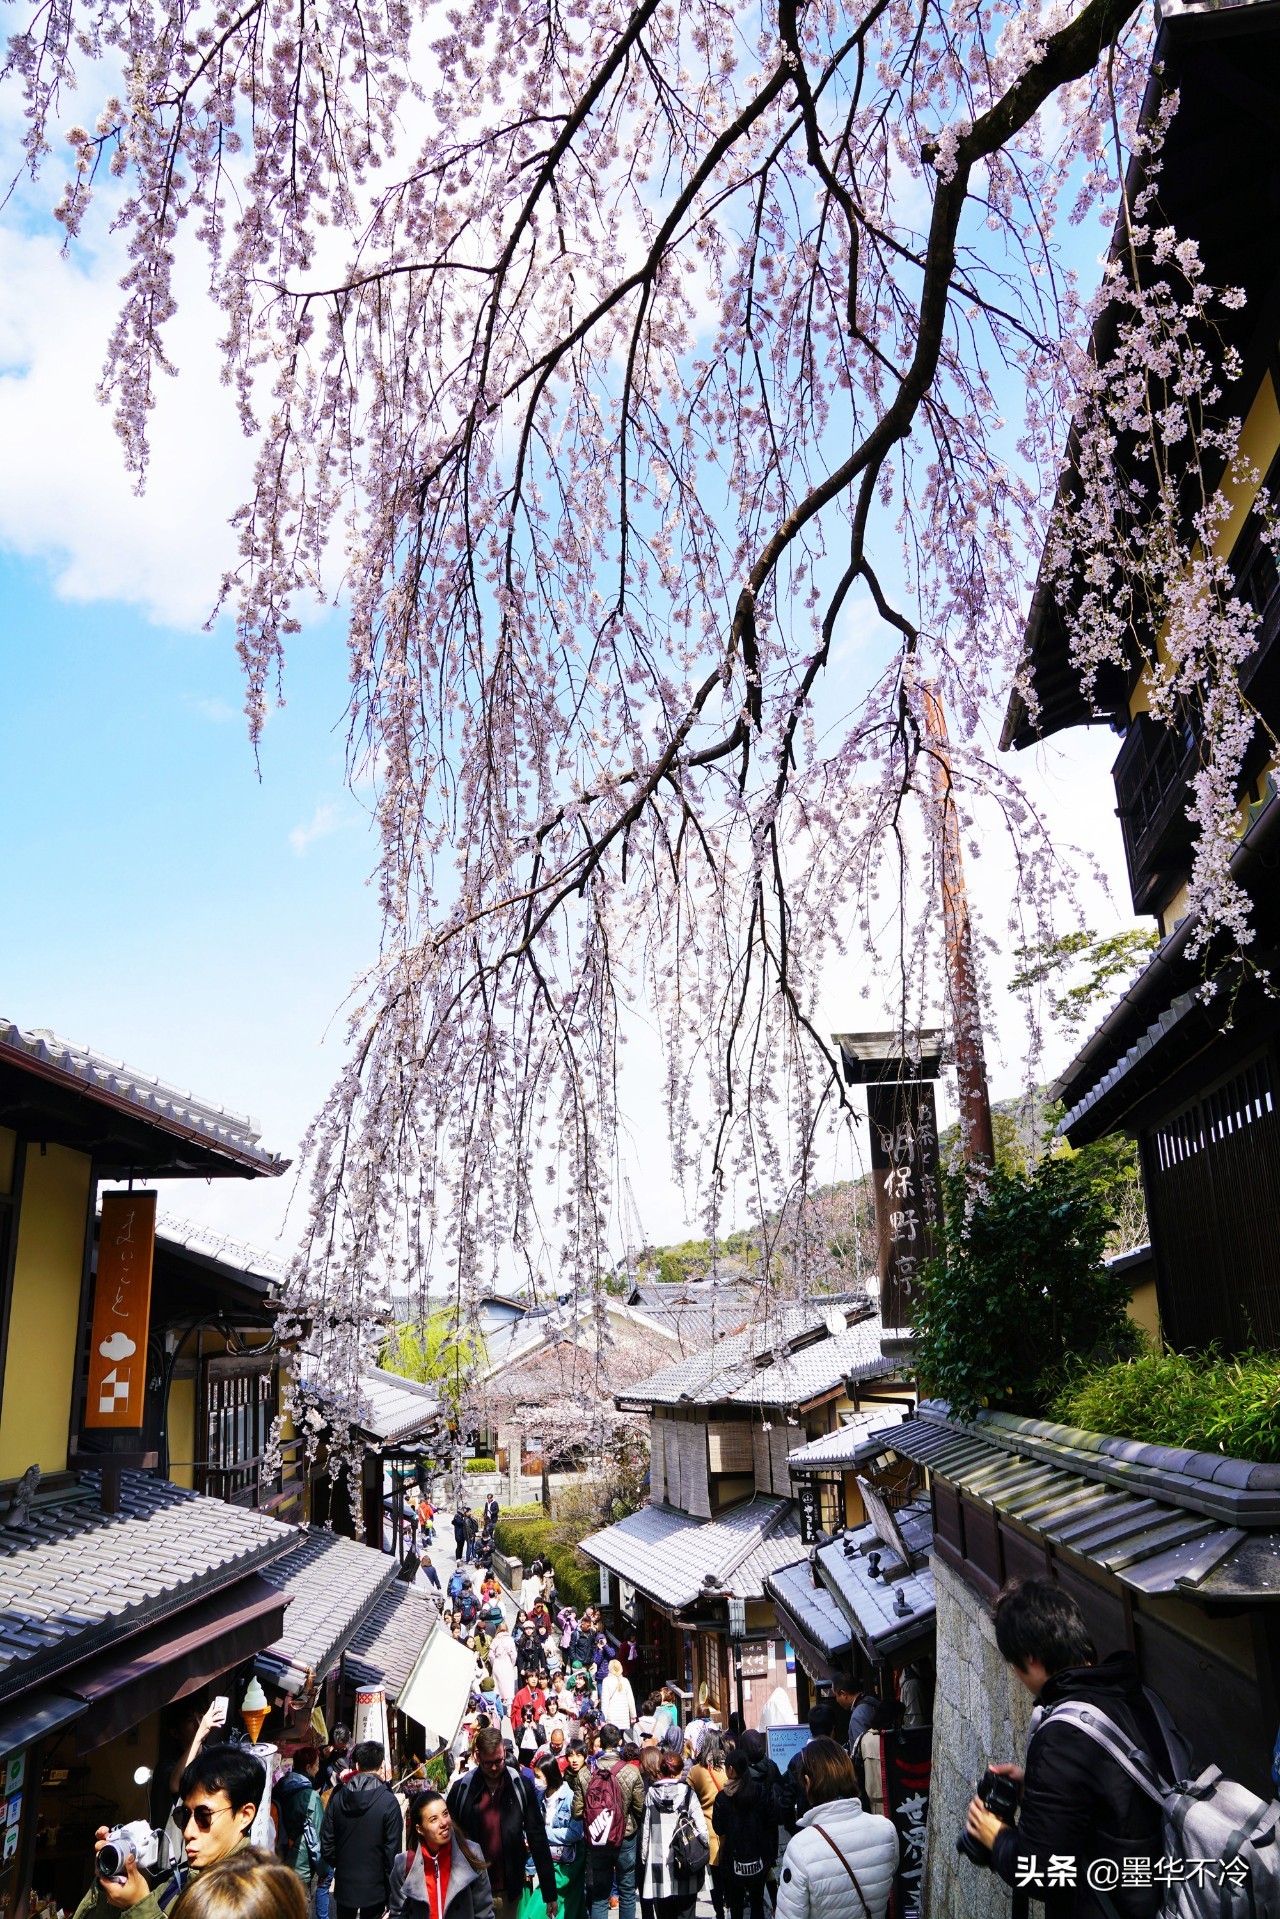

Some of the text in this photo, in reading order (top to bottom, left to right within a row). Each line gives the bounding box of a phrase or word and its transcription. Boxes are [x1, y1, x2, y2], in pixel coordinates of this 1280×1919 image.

[881, 1122, 921, 1296] 明保野亭
[588, 1808, 614, 1840] NIKE
